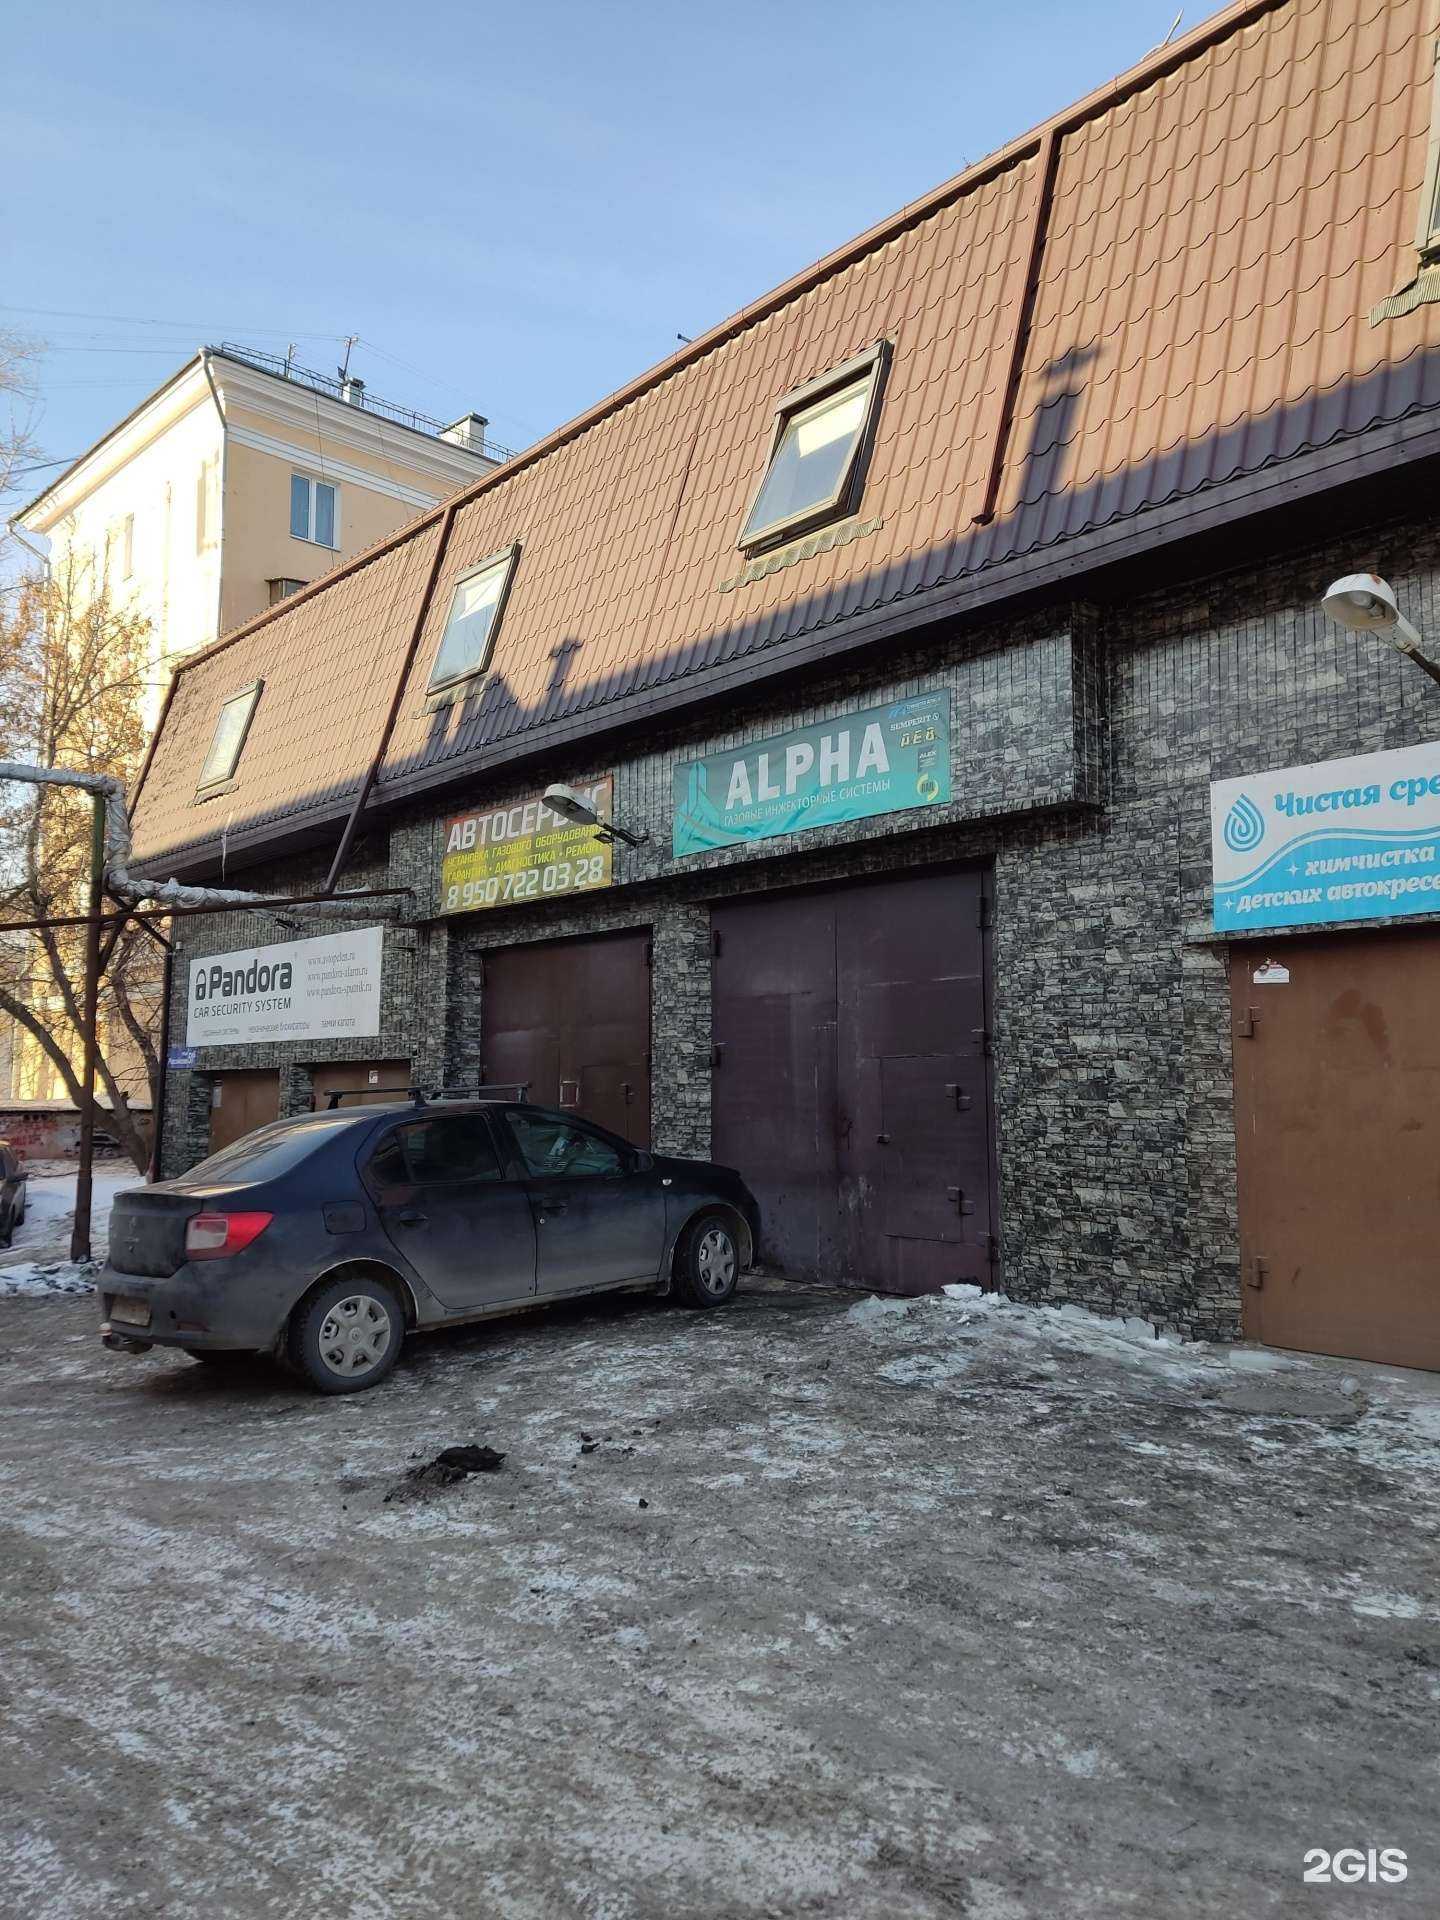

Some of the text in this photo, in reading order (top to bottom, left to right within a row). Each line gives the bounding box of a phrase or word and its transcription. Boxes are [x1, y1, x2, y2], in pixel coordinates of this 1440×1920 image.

[725, 722, 890, 810] ALPHA
[447, 782, 608, 853] АВТОСЕРС
[723, 779, 890, 827] ГАЗОВЫЕ ИНЖЕКТОРНЫЕ СИСТЕМЫ
[1273, 785, 1380, 818] Чистая
[447, 848, 489, 867] УСТАНОВКА
[491, 838, 532, 857] ГАЗОВОГО
[495, 851, 557, 875] ДИАГНОСТИКА
[1304, 845, 1435, 876] химчистка
[446, 855, 605, 909] 8 950 722 03 28
[1236, 887, 1323, 914] детских
[208, 959, 293, 1000] Pandora
[193, 997, 292, 1018] CAR SECURITY SYSTEM
